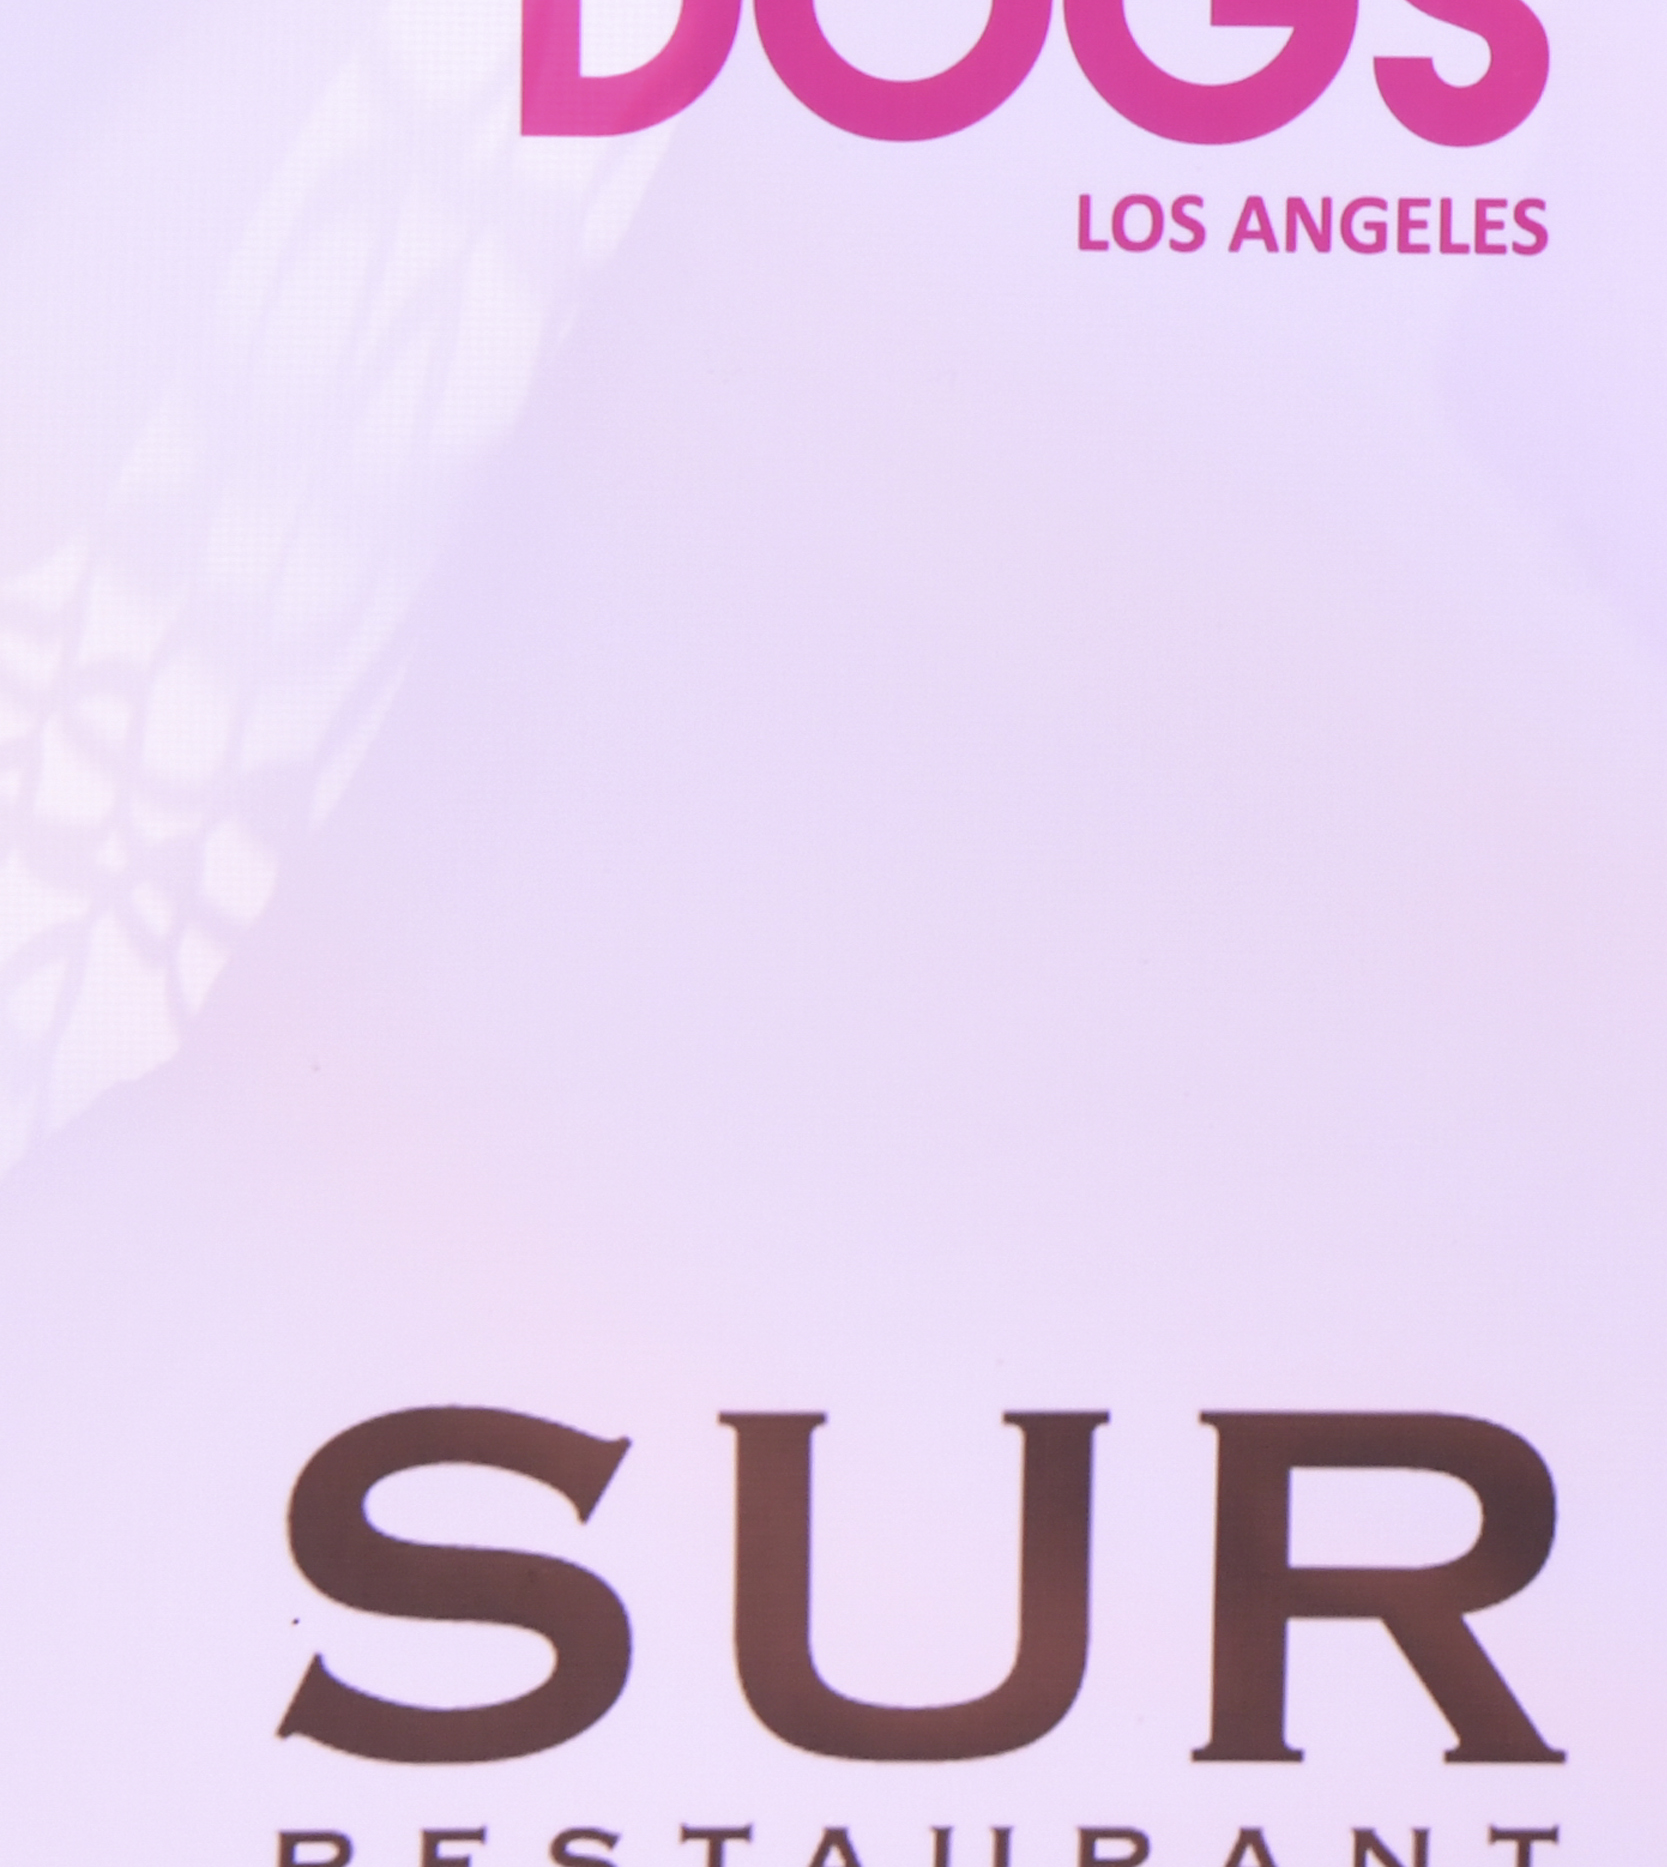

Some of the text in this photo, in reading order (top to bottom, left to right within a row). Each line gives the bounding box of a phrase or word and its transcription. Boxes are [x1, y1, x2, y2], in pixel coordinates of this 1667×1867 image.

[1077, 193, 1550, 257] LOS ANGELES
[275, 1404, 1568, 1765] SUR
